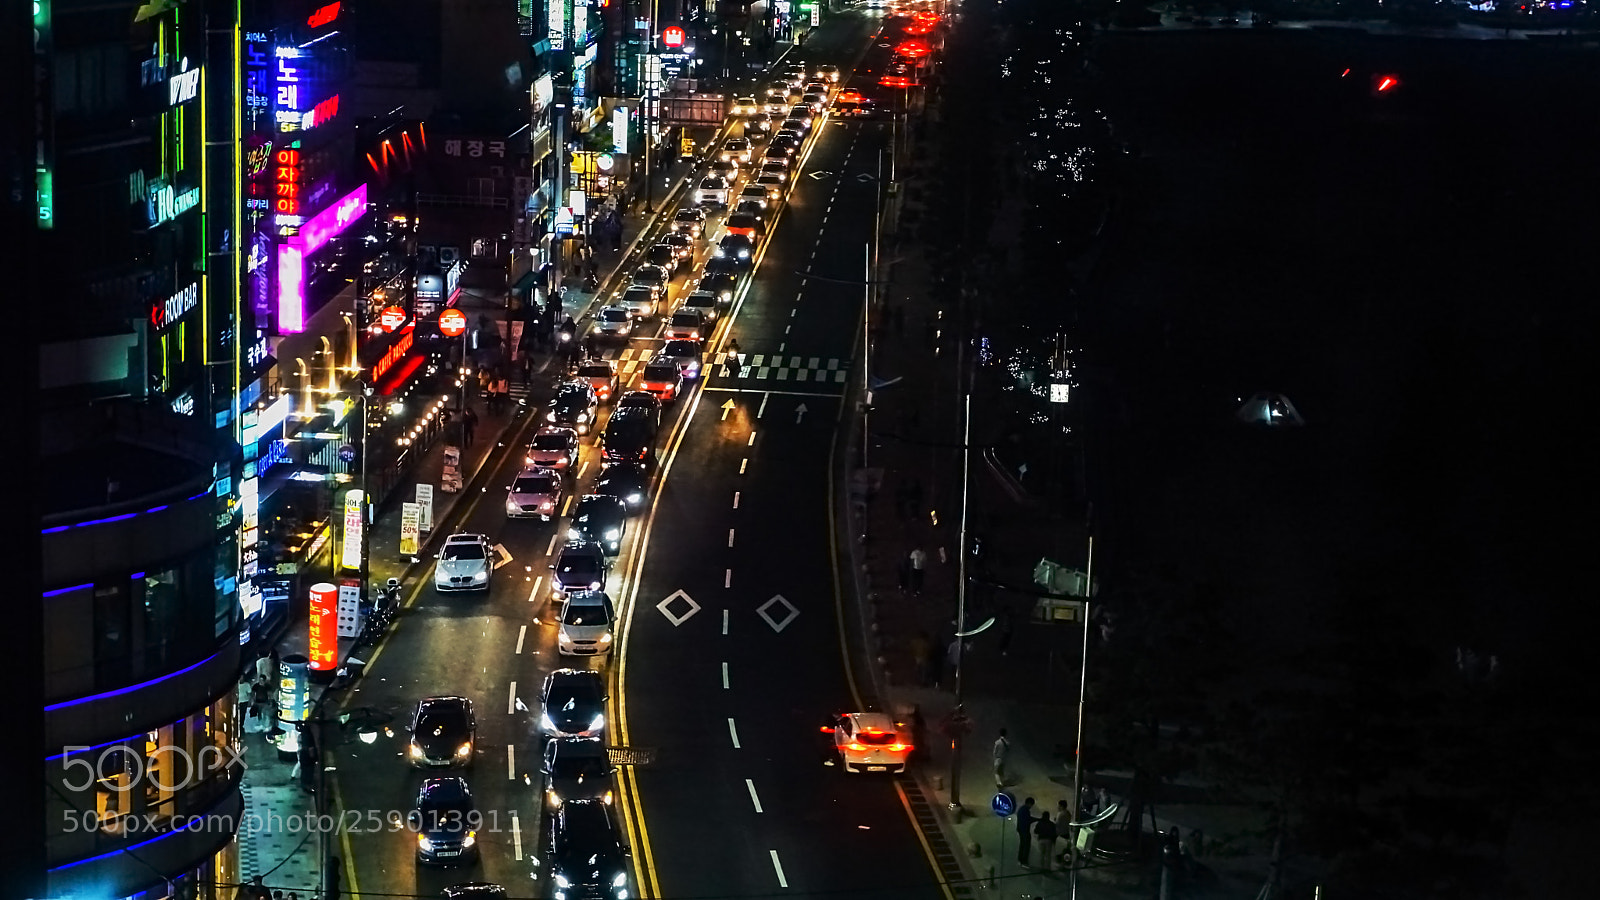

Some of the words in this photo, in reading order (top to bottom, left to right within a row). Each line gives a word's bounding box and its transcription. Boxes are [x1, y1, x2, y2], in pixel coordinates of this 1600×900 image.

[276, 59, 299, 110] 노래
[445, 139, 506, 158] 해장국
[277, 151, 298, 214] 이자까야
[184, 281, 197, 313] BAR
